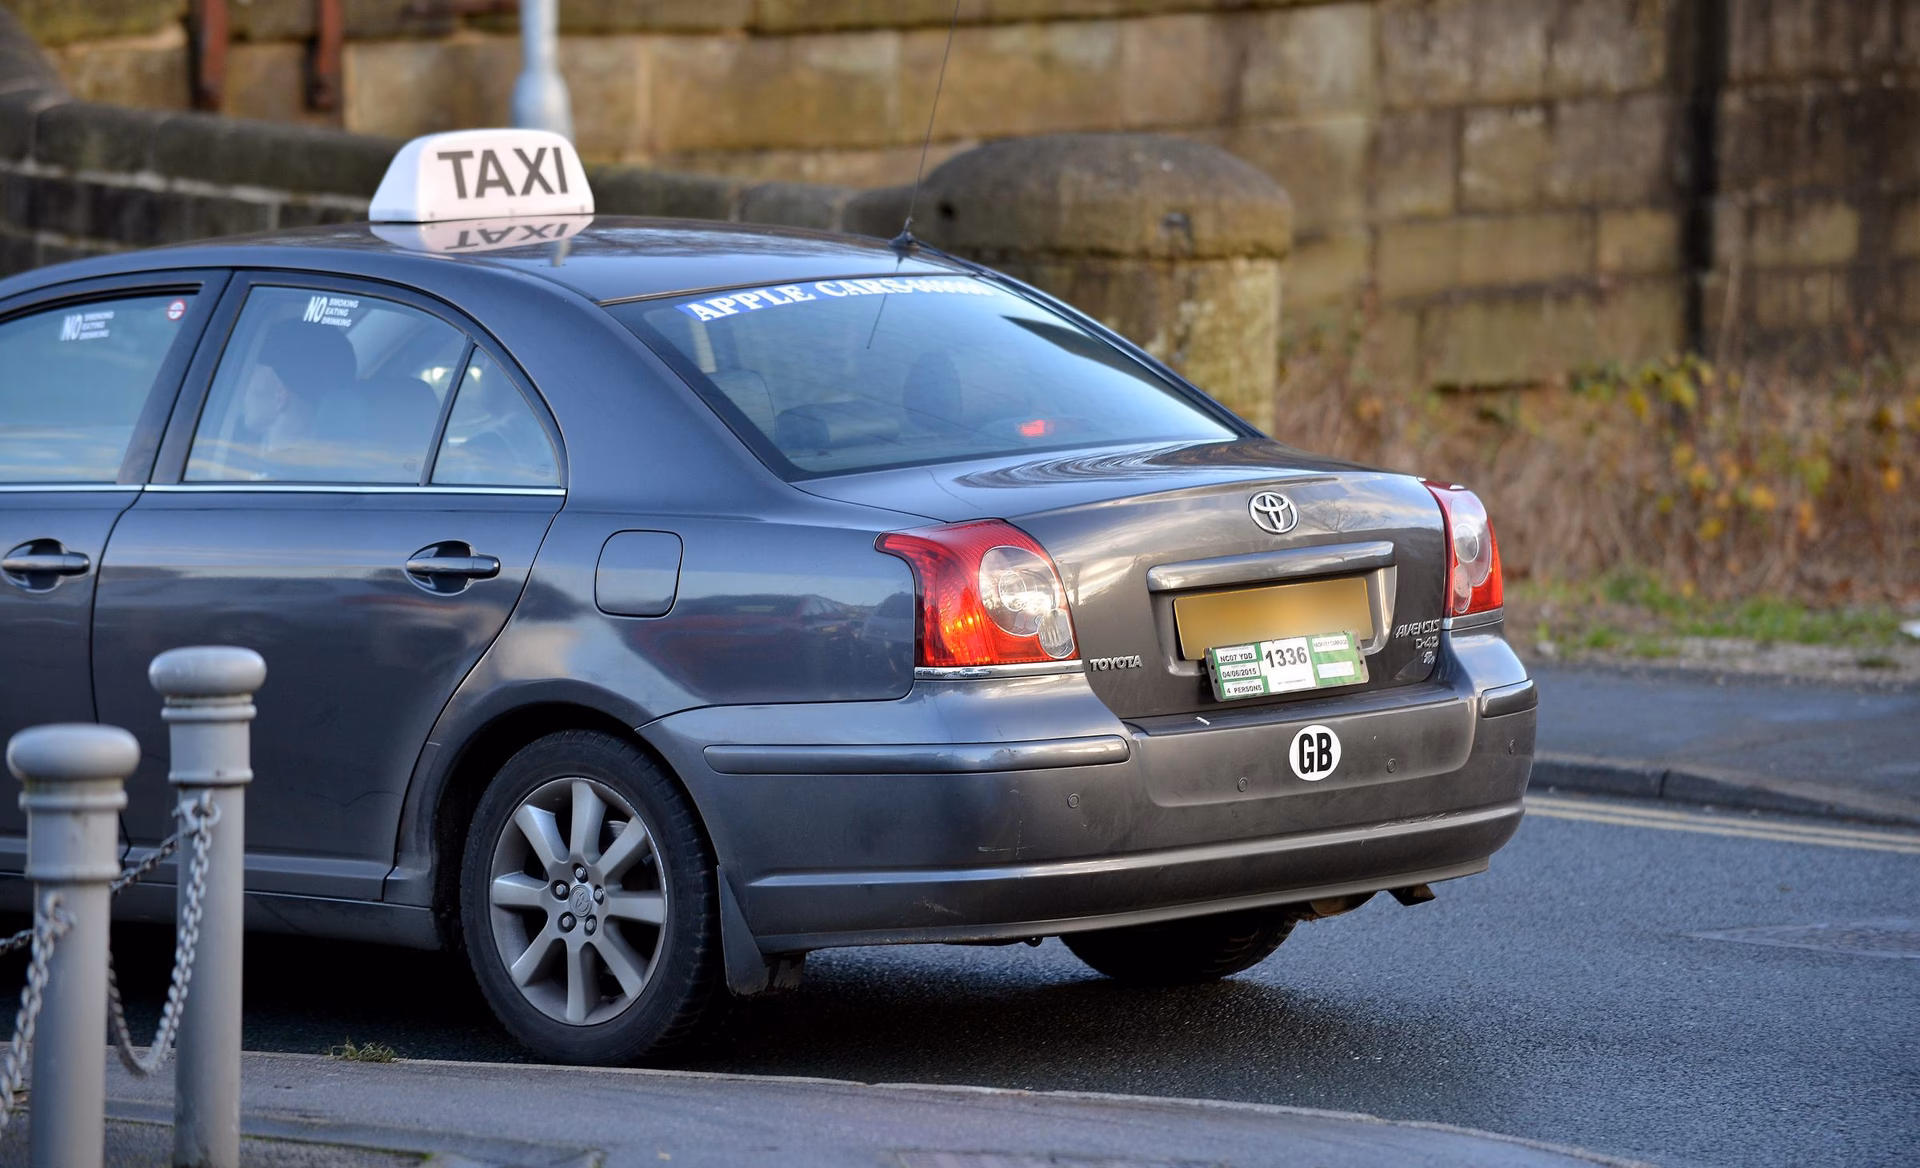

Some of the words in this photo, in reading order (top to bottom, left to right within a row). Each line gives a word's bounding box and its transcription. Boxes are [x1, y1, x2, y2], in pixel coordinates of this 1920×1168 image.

[437, 147, 568, 199] TAXI
[303, 296, 328, 323] NO
[329, 297, 359, 308] SMOKING
[686, 285, 817, 321] APPLE
[815, 279, 912, 297] CARS
[324, 308, 349, 317] EATING
[60, 314, 82, 341] NO
[1394, 618, 1440, 638] AVENSIS
[1090, 655, 1142, 671] TOYOTA
[1265, 646, 1307, 668] 1336
[1234, 685, 1262, 694] PERSONS
[1299, 732, 1332, 774] GB
